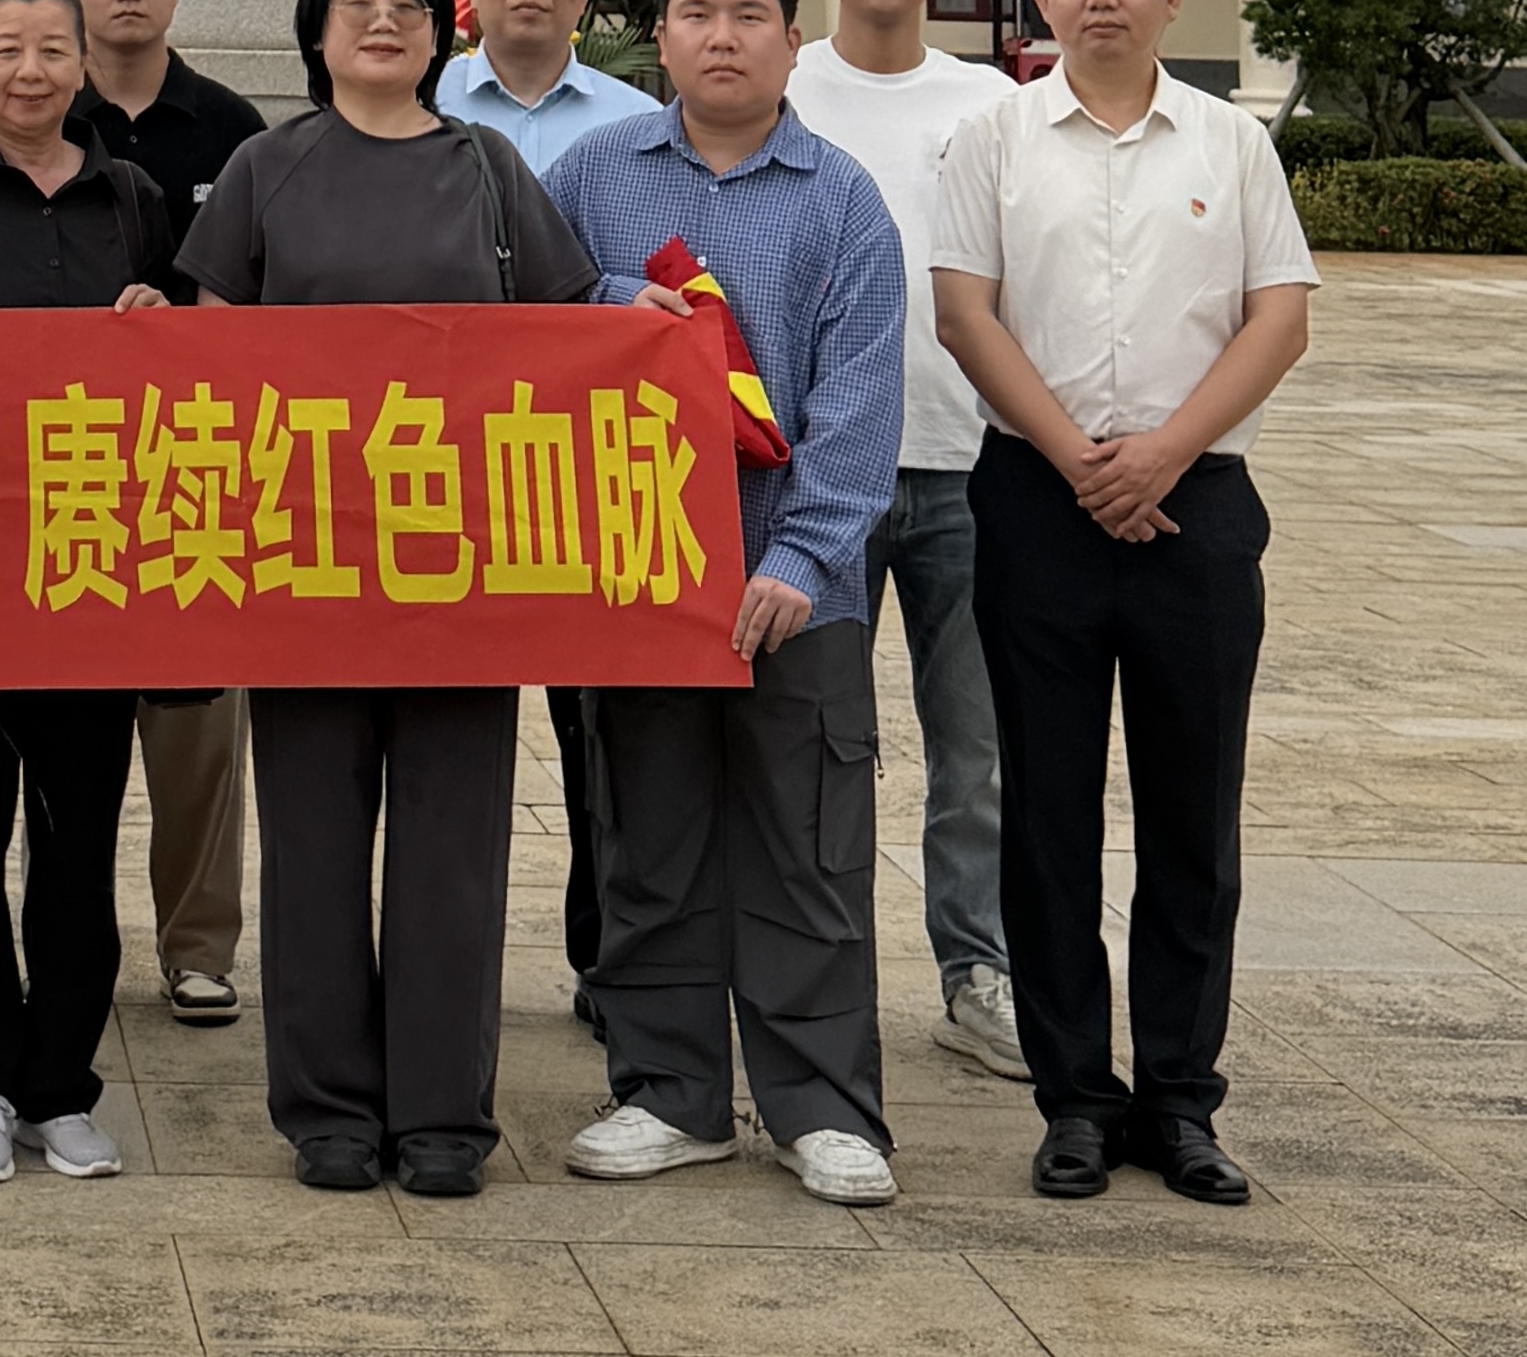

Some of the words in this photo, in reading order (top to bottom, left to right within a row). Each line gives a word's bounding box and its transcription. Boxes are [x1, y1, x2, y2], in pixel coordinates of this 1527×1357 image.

[24, 380, 708, 612] 赓续红色血脉
